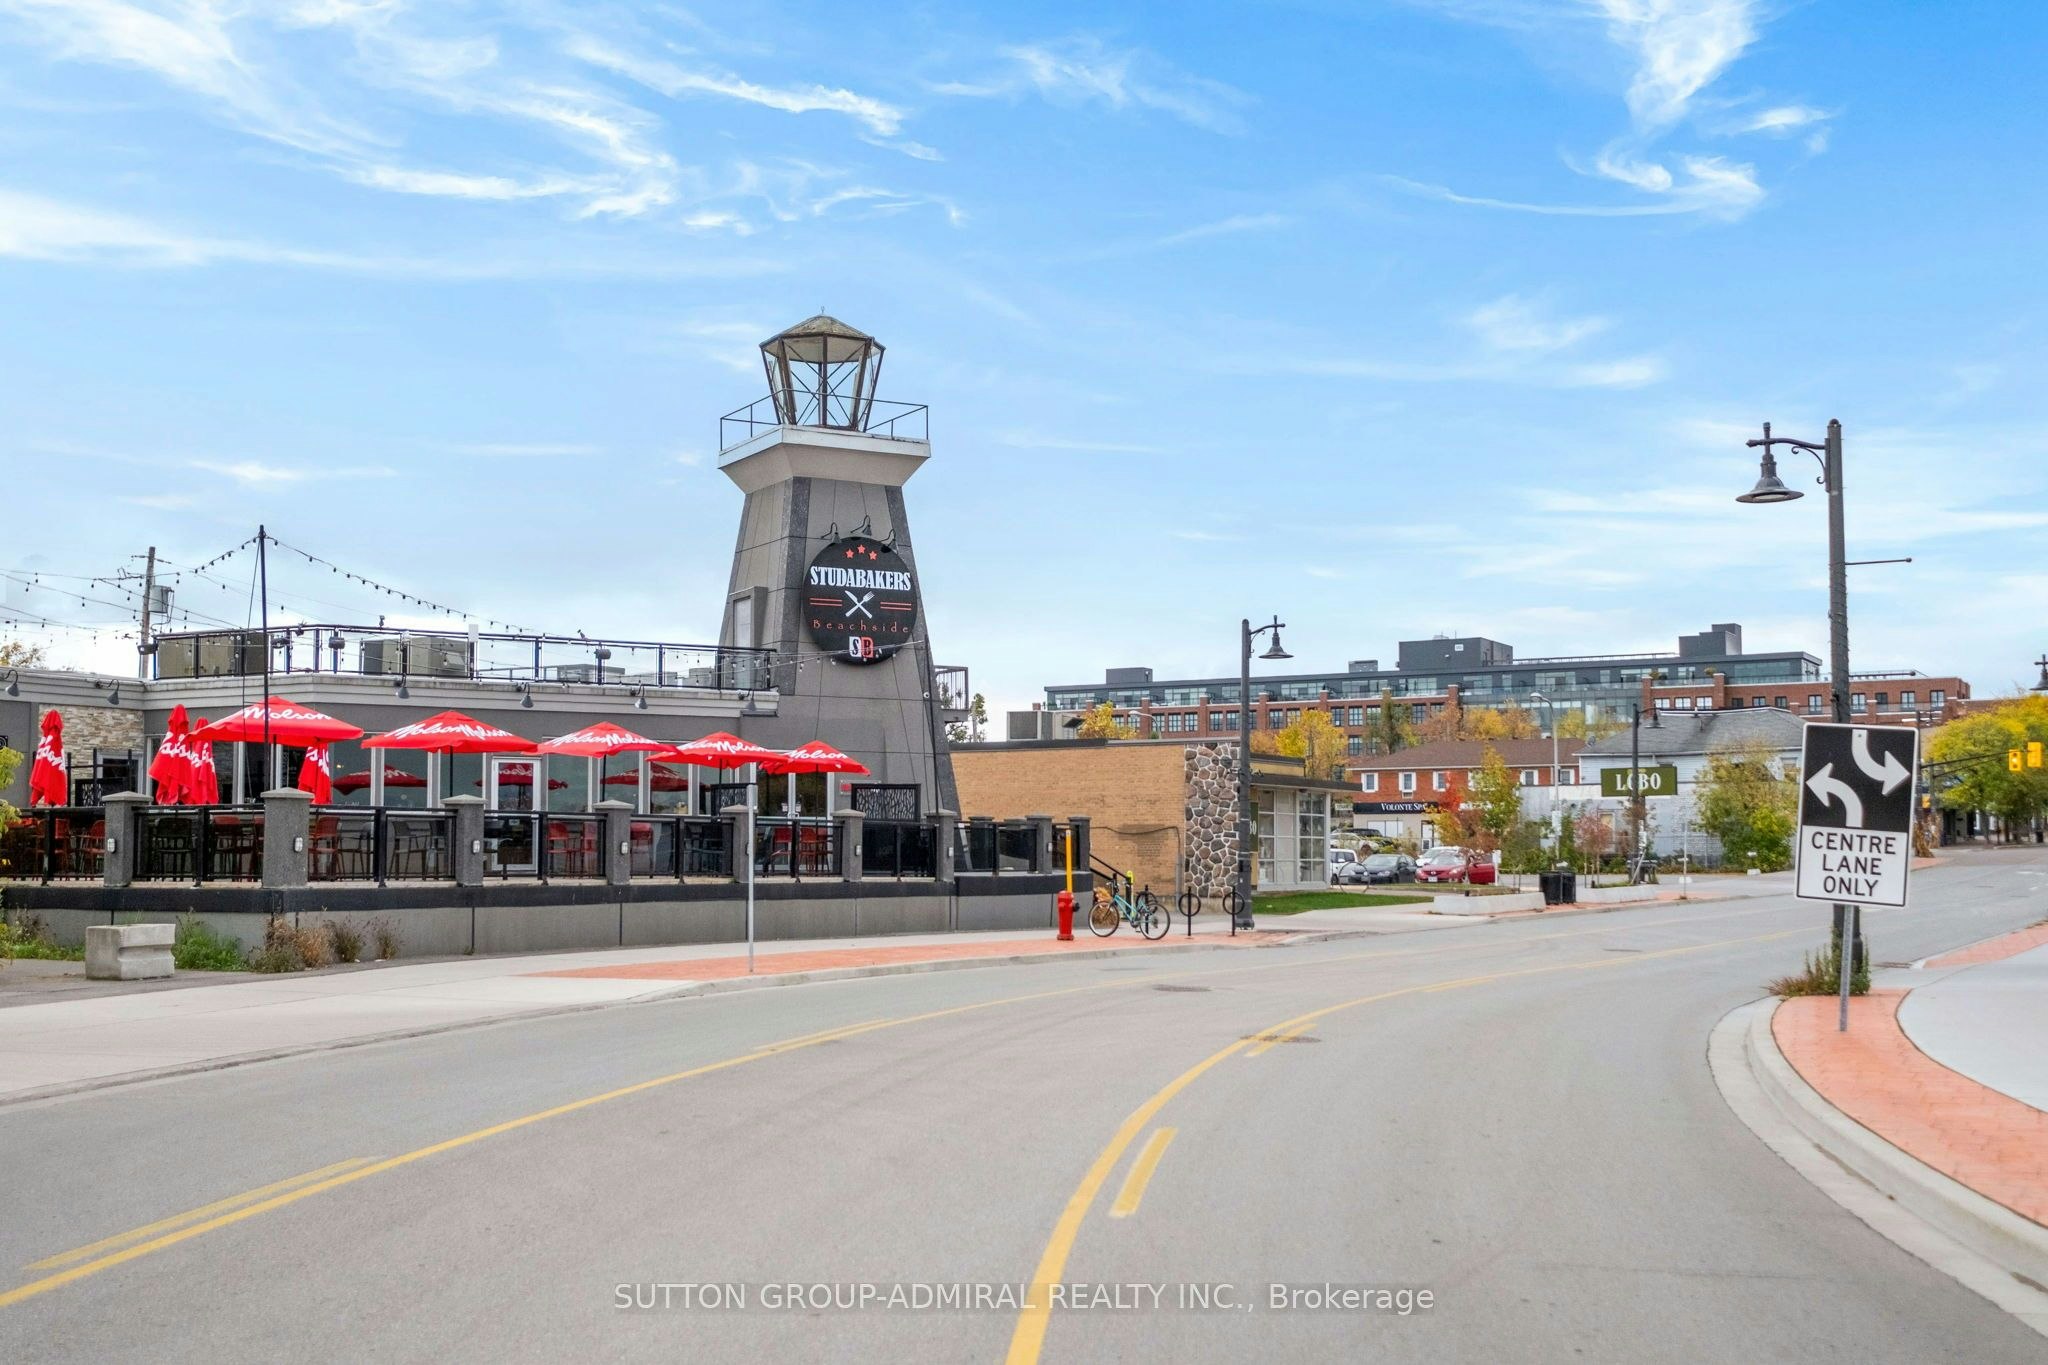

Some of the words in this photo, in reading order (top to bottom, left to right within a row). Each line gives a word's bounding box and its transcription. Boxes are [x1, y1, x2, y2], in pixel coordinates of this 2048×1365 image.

[810, 566, 911, 591] STUDABAKERS
[812, 619, 909, 633] Beachside
[1811, 831, 1896, 854] CENTRE
[1822, 853, 1882, 875] LANE
[1823, 876, 1878, 896] ONLY
